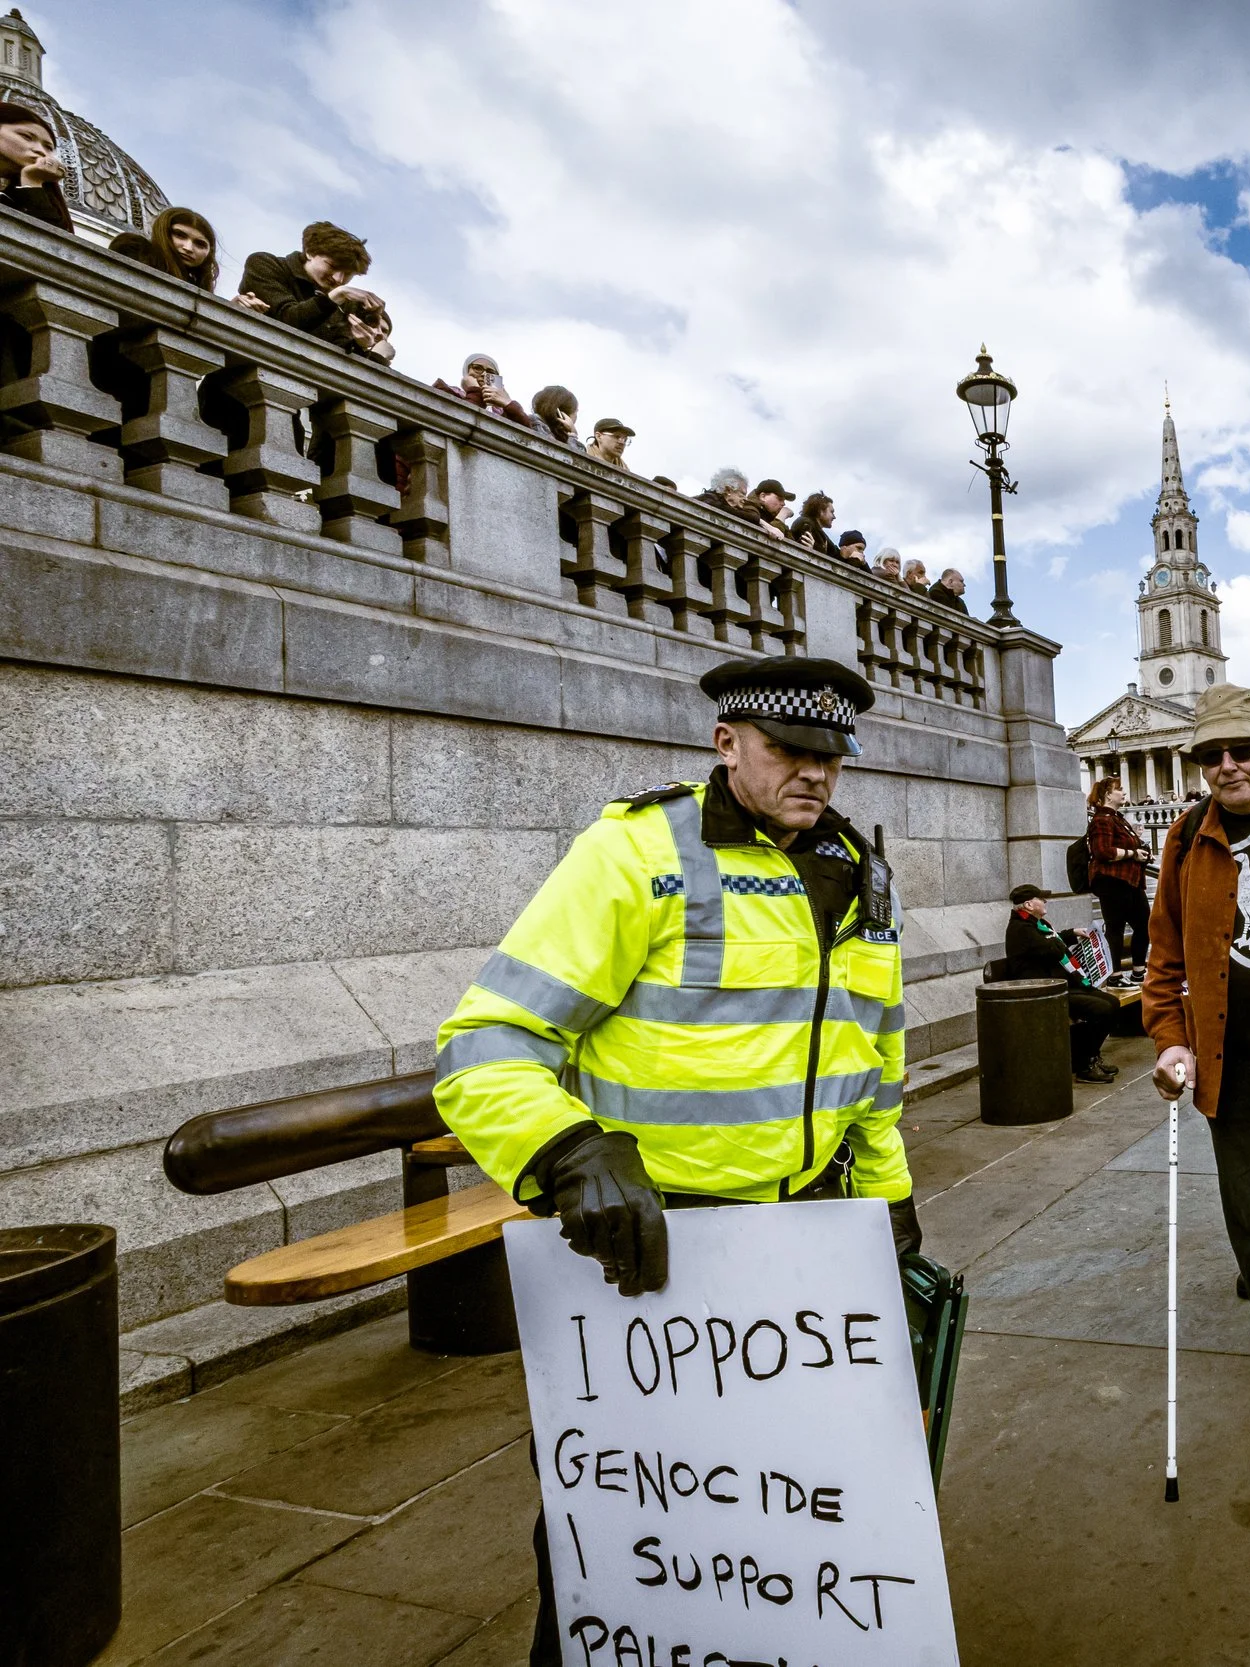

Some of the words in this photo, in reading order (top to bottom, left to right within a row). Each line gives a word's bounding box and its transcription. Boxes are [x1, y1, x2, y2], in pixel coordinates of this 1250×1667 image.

[1094, 949, 1103, 962] THE
[1099, 961, 1108, 977] BAN
[570, 1314, 600, 1402] I
[625, 1310, 884, 1398] OPPOSE
[554, 1428, 845, 1523] GENOCIDE
[566, 1512, 588, 1580] I
[632, 1536, 916, 1632] SUPPORT
